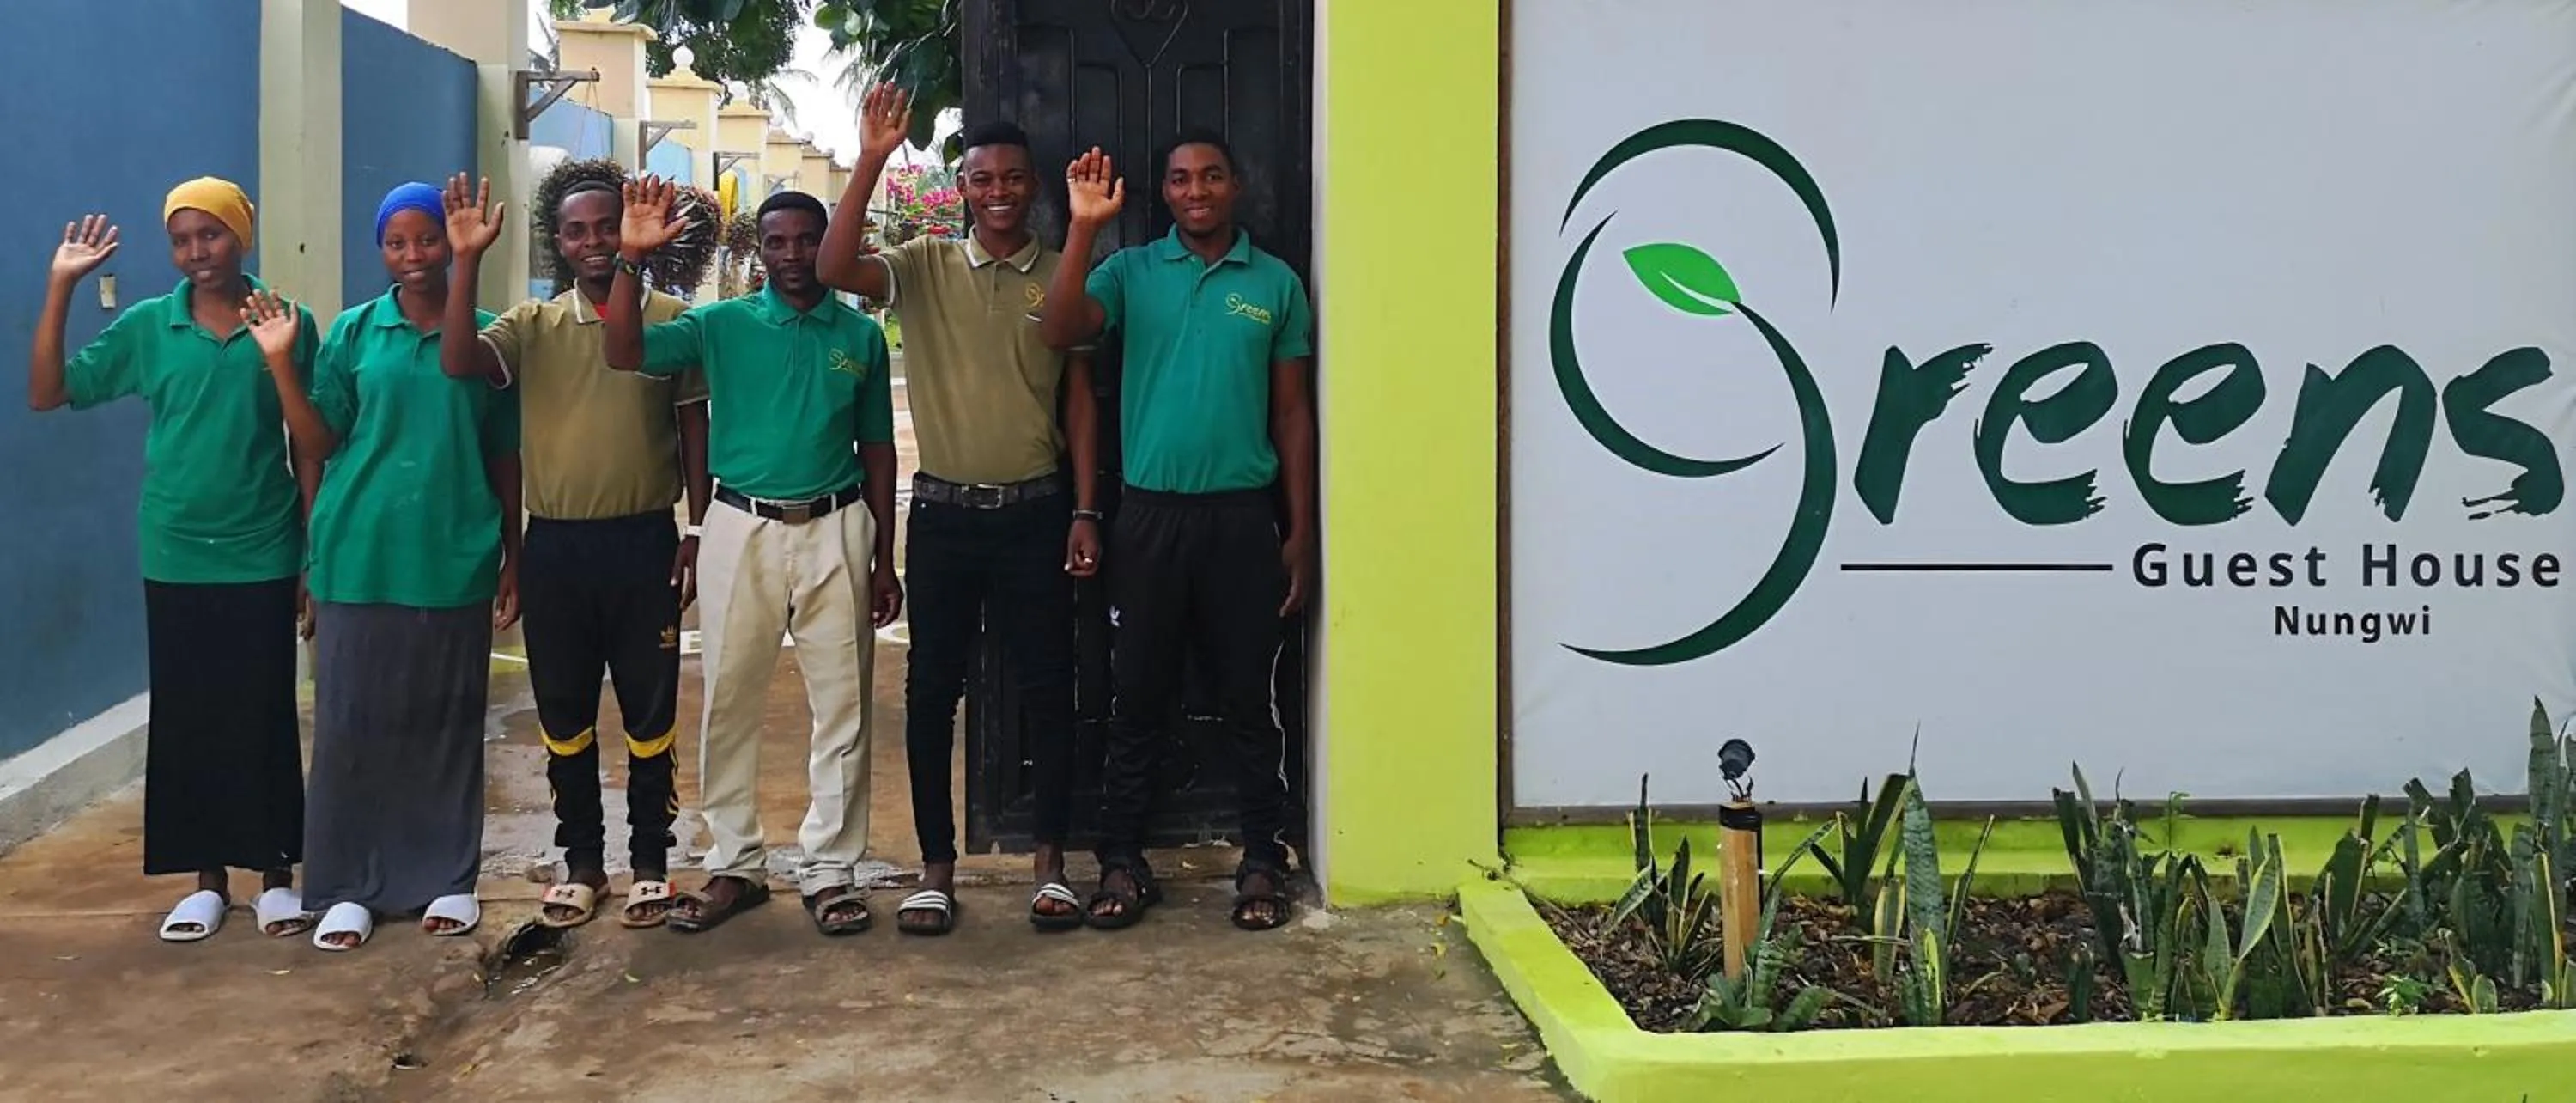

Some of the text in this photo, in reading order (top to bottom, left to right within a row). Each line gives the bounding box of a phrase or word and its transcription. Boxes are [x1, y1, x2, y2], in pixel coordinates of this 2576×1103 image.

[1550, 119, 2565, 666] Greens
[2131, 542, 2561, 588] Guest House
[2274, 604, 2431, 643] Nungwi
